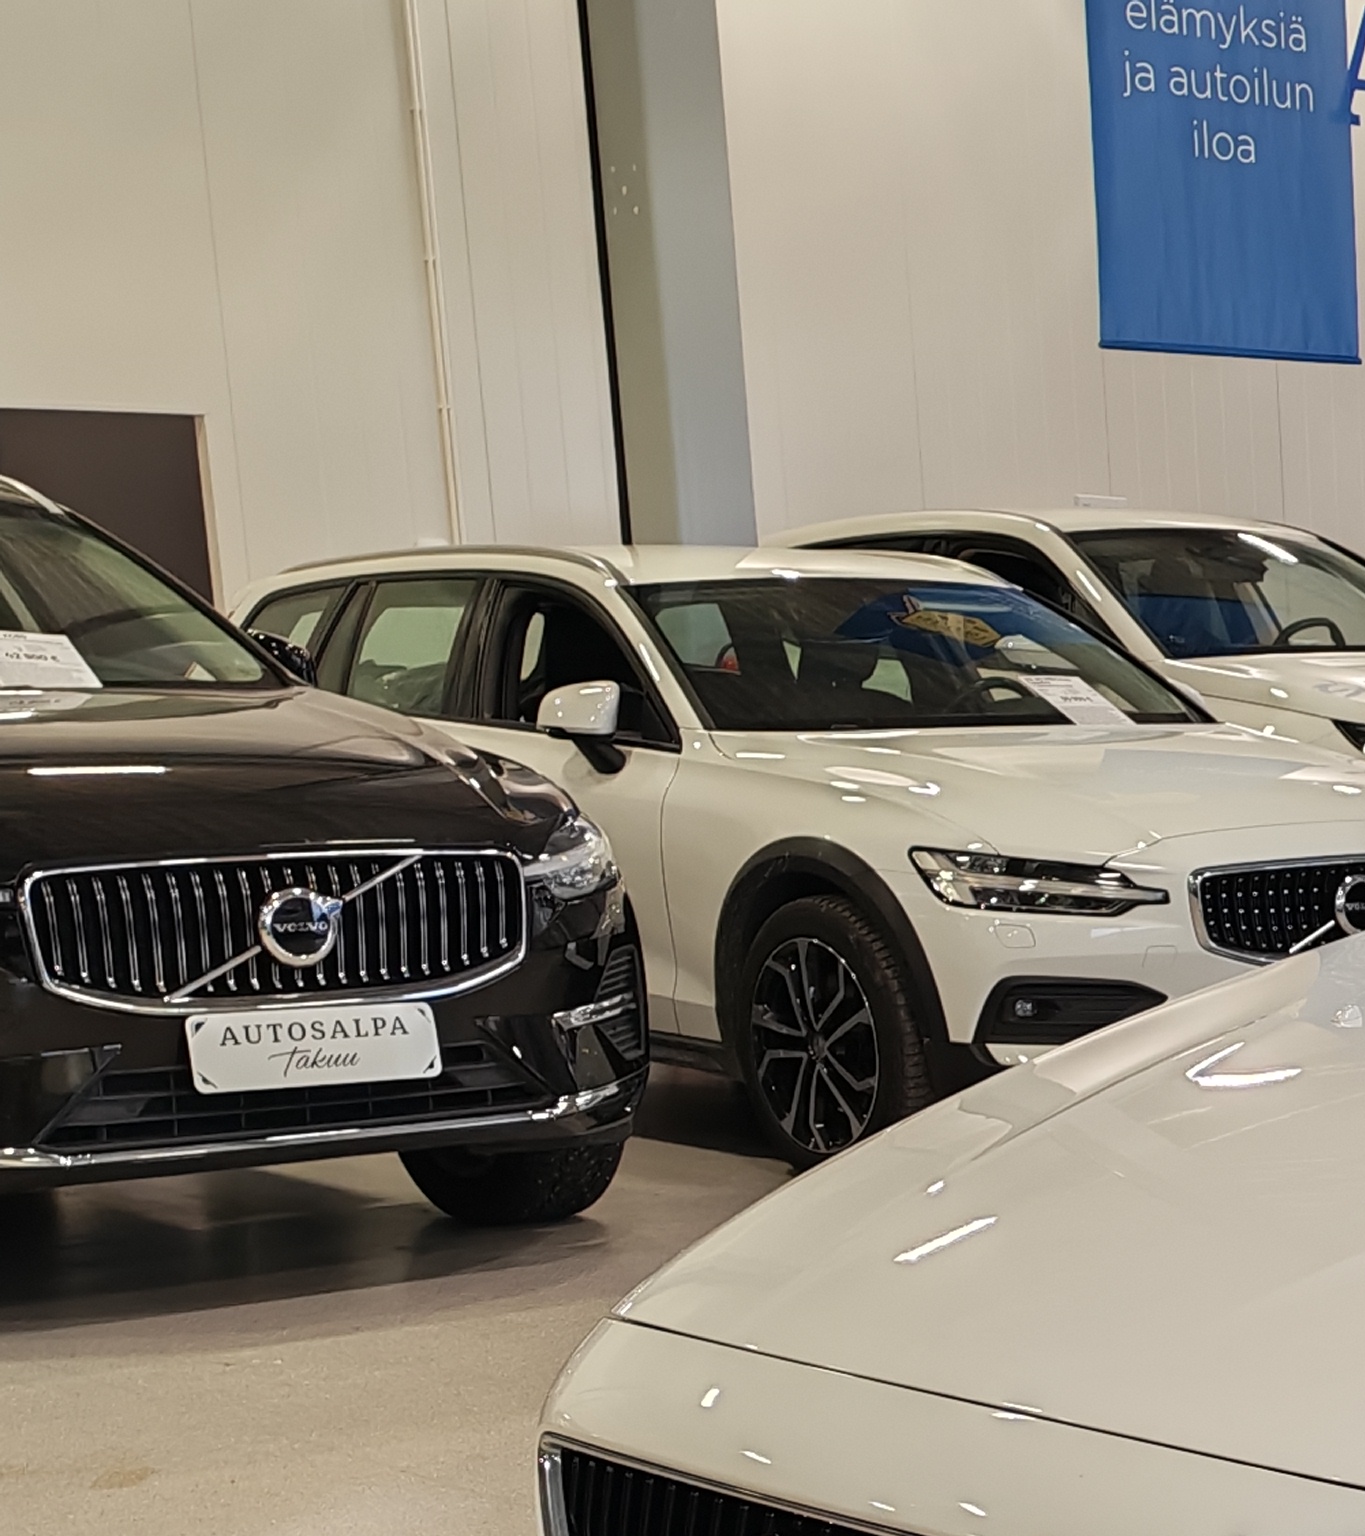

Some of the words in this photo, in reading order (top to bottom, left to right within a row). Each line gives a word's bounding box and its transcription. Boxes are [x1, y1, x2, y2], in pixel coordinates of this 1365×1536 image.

[1126, 0, 1307, 52] elämyksiä
[1123, 50, 1155, 97] ja
[1169, 64, 1314, 112] autoilun
[1193, 119, 1256, 163] iloa
[273, 922, 329, 932] VOLVO
[219, 1015, 410, 1047] AUTOSALPA
[268, 1046, 361, 1078] Takuu
